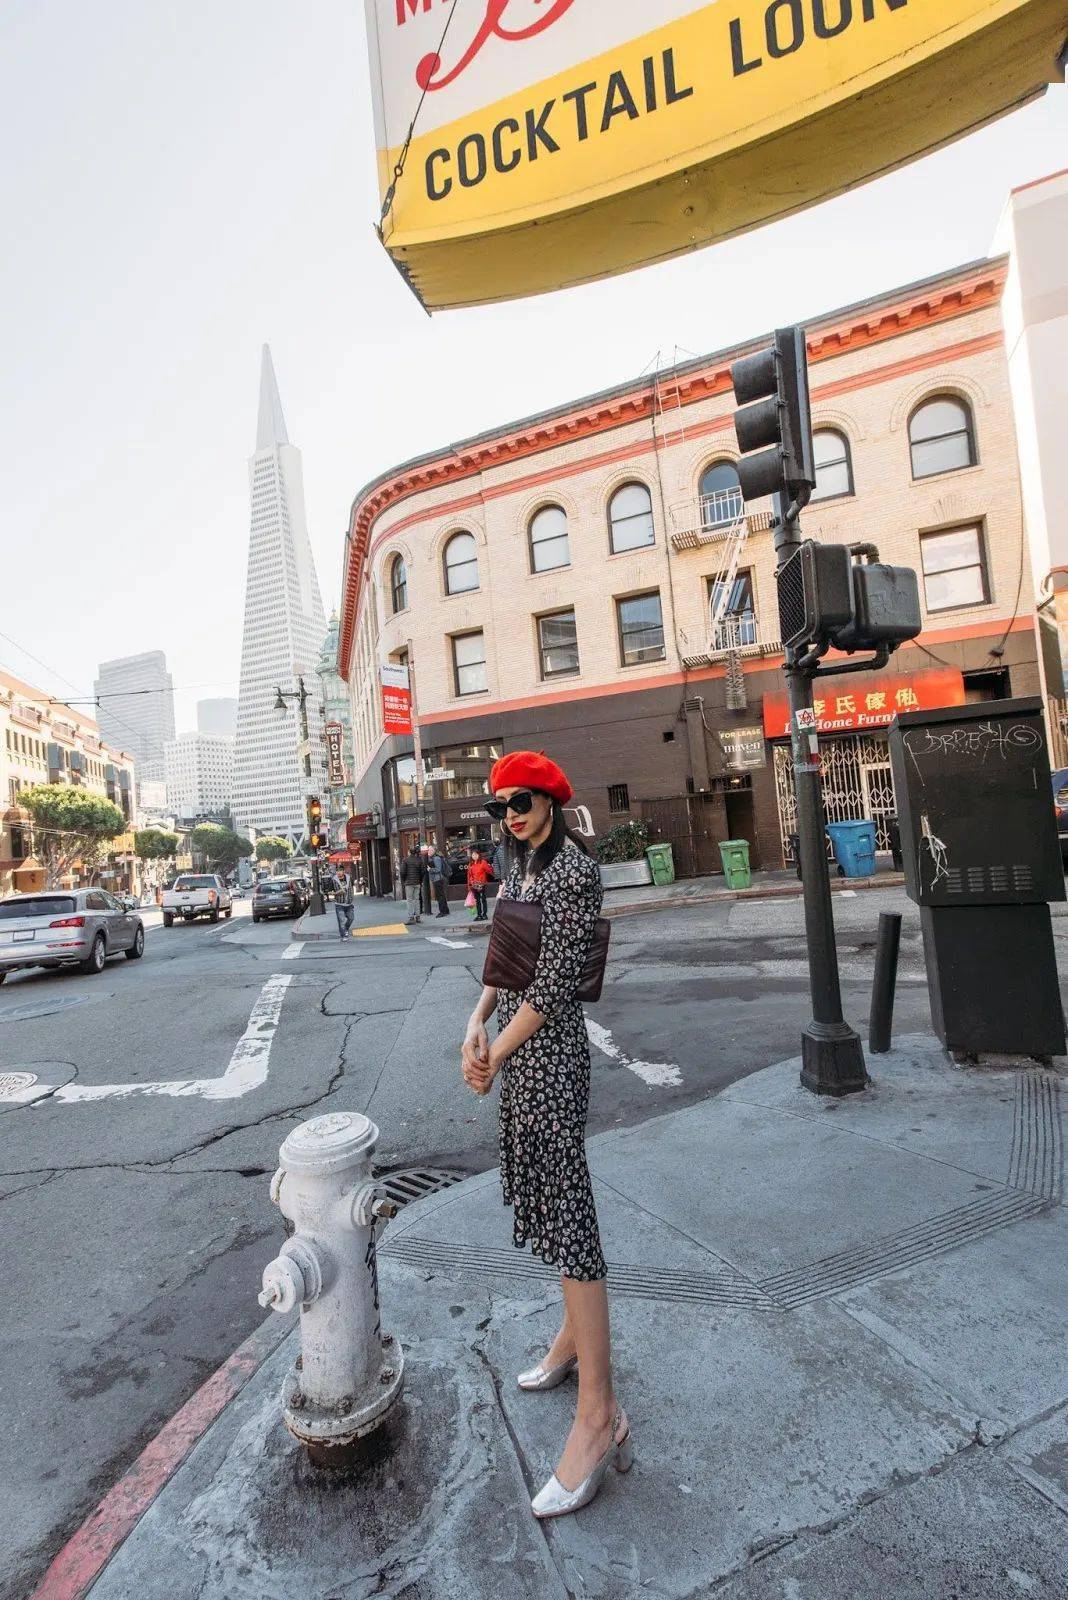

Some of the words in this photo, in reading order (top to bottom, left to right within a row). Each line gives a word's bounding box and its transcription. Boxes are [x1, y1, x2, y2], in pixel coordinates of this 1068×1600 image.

[424, 48, 694, 201] COCKTAIL
[720, 731, 736, 739] FOR
[738, 729, 760, 737] LEASE
[723, 742, 761, 753] maven
[331, 735, 340, 776] HOTEL
[428, 772, 449, 780] PACIFIC
